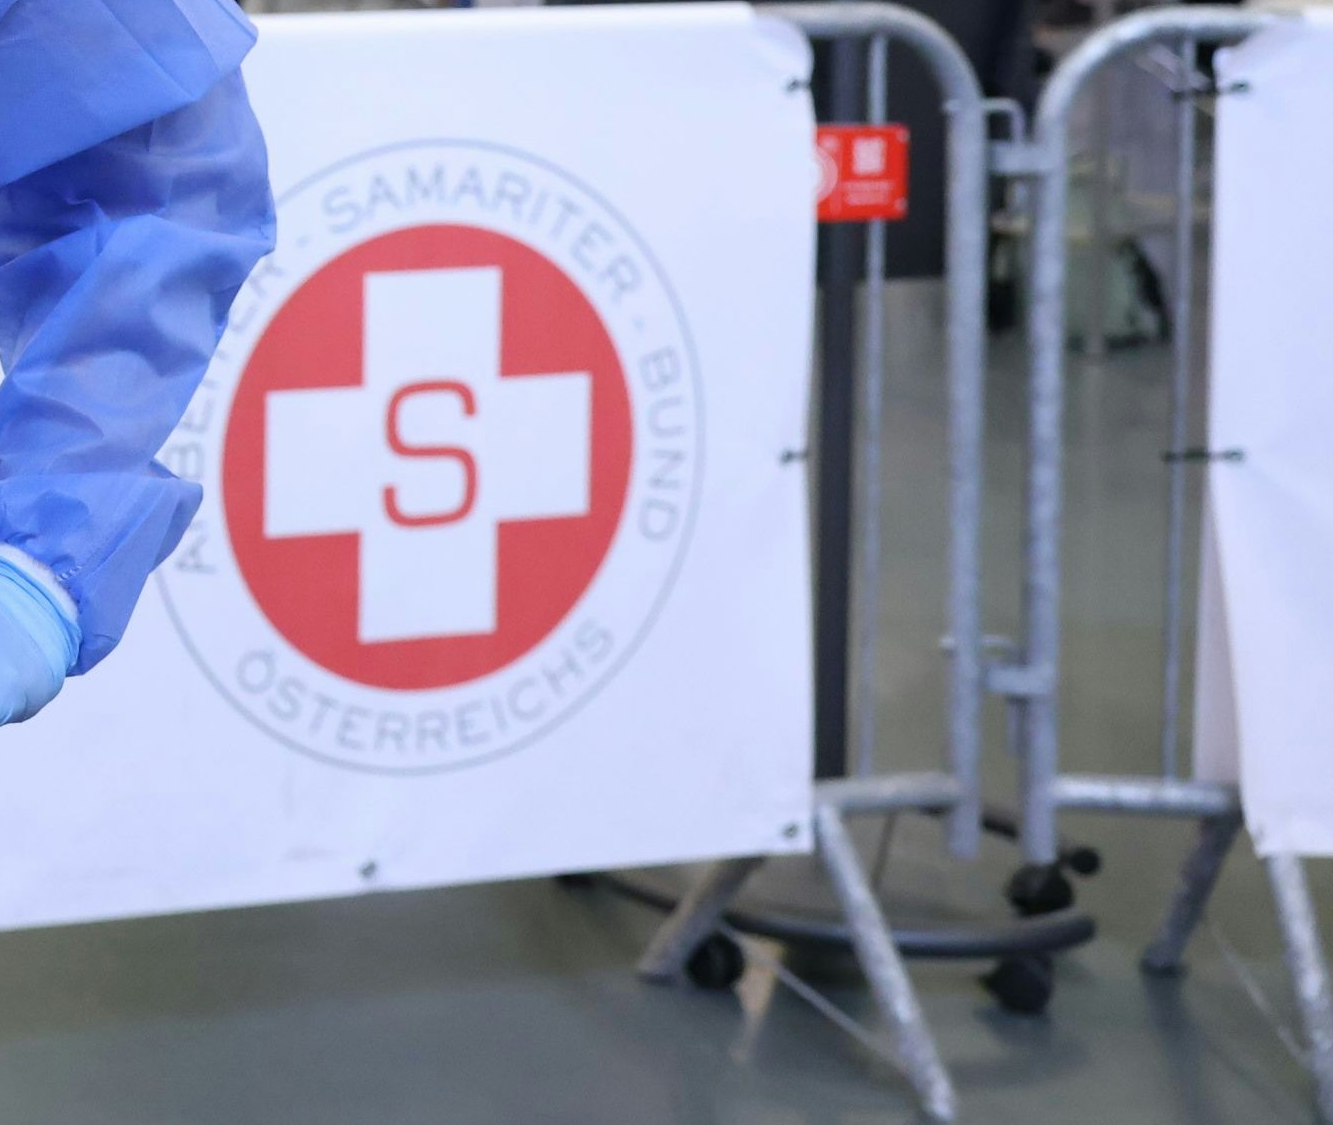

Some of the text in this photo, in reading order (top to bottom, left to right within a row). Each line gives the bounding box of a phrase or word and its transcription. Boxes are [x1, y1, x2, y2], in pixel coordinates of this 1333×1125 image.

[321, 163, 644, 303] SAMARITER
[636, 345, 686, 544] BUND
[381, 377, 479, 530] S
[235, 617, 617, 756] ÖSTERREICHS
